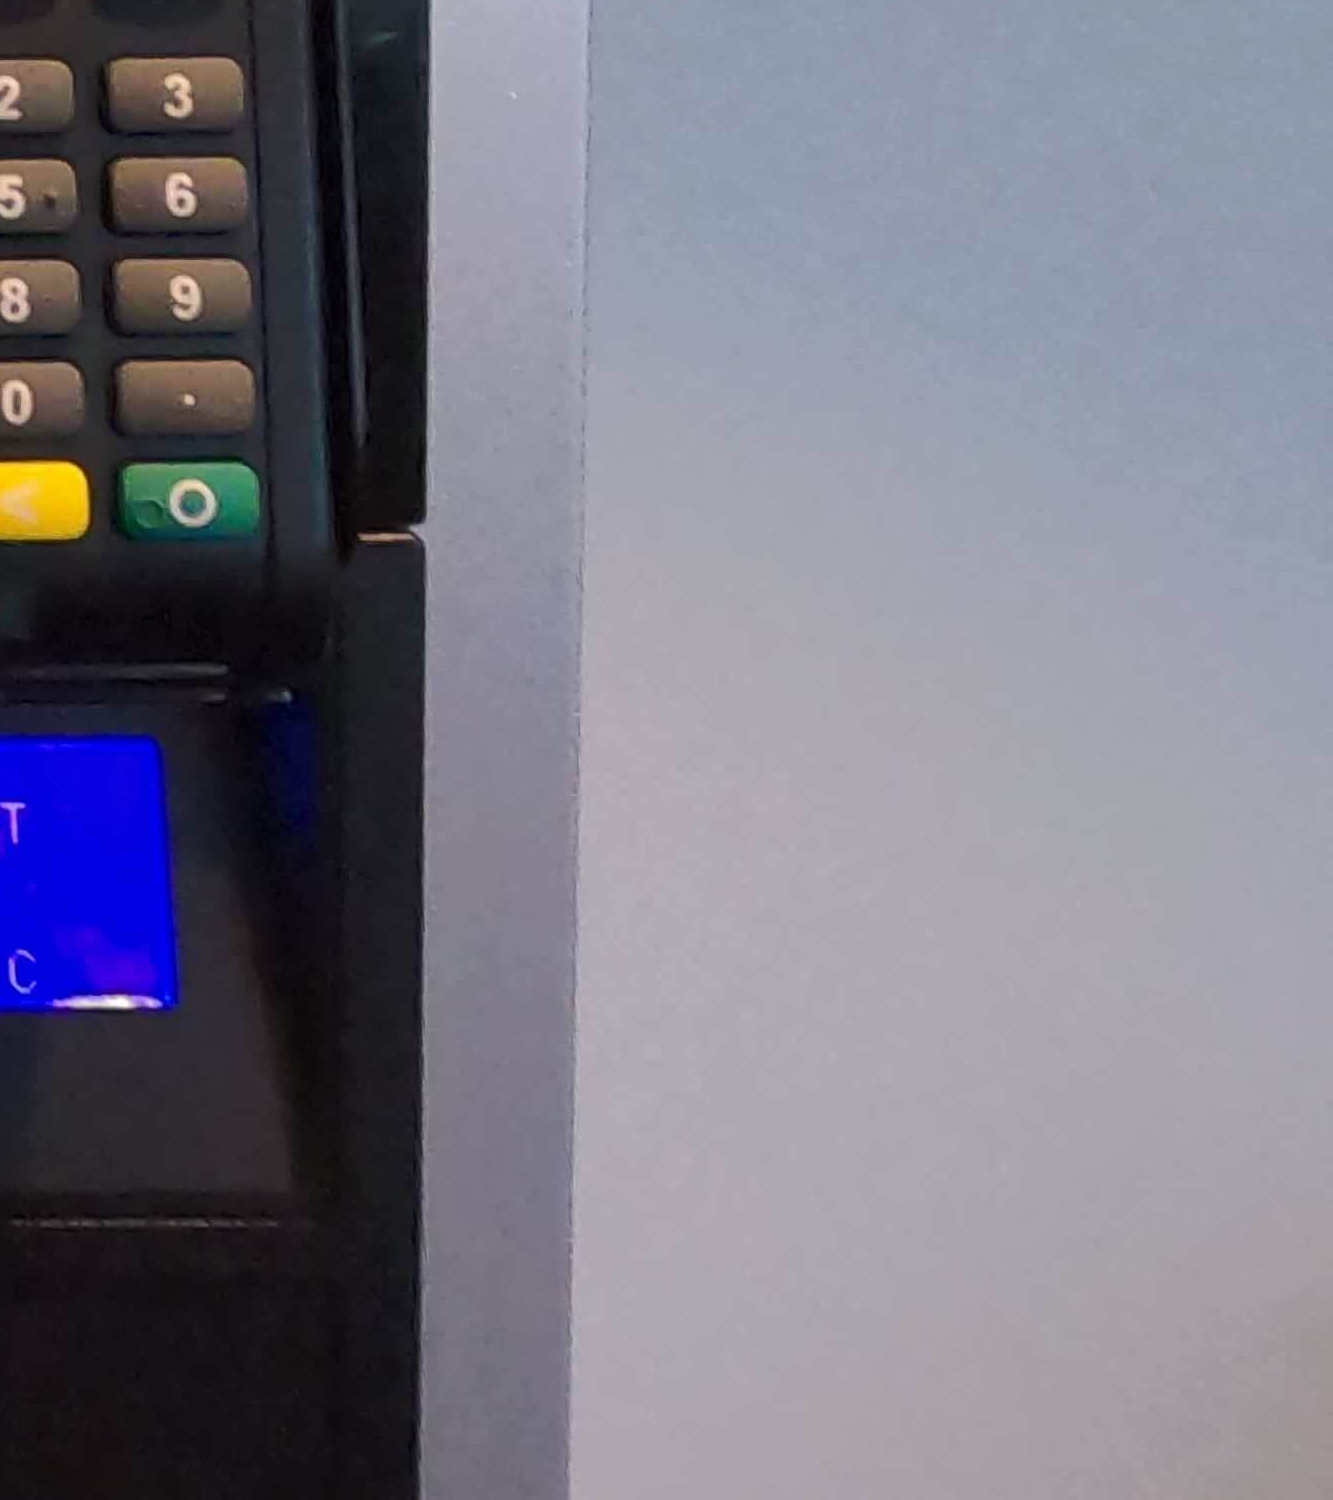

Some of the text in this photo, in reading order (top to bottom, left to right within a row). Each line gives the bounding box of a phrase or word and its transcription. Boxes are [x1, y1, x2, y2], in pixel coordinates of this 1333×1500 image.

[163, 74, 194, 118] 3
[165, 173, 197, 218] 6
[169, 275, 202, 321] 9
